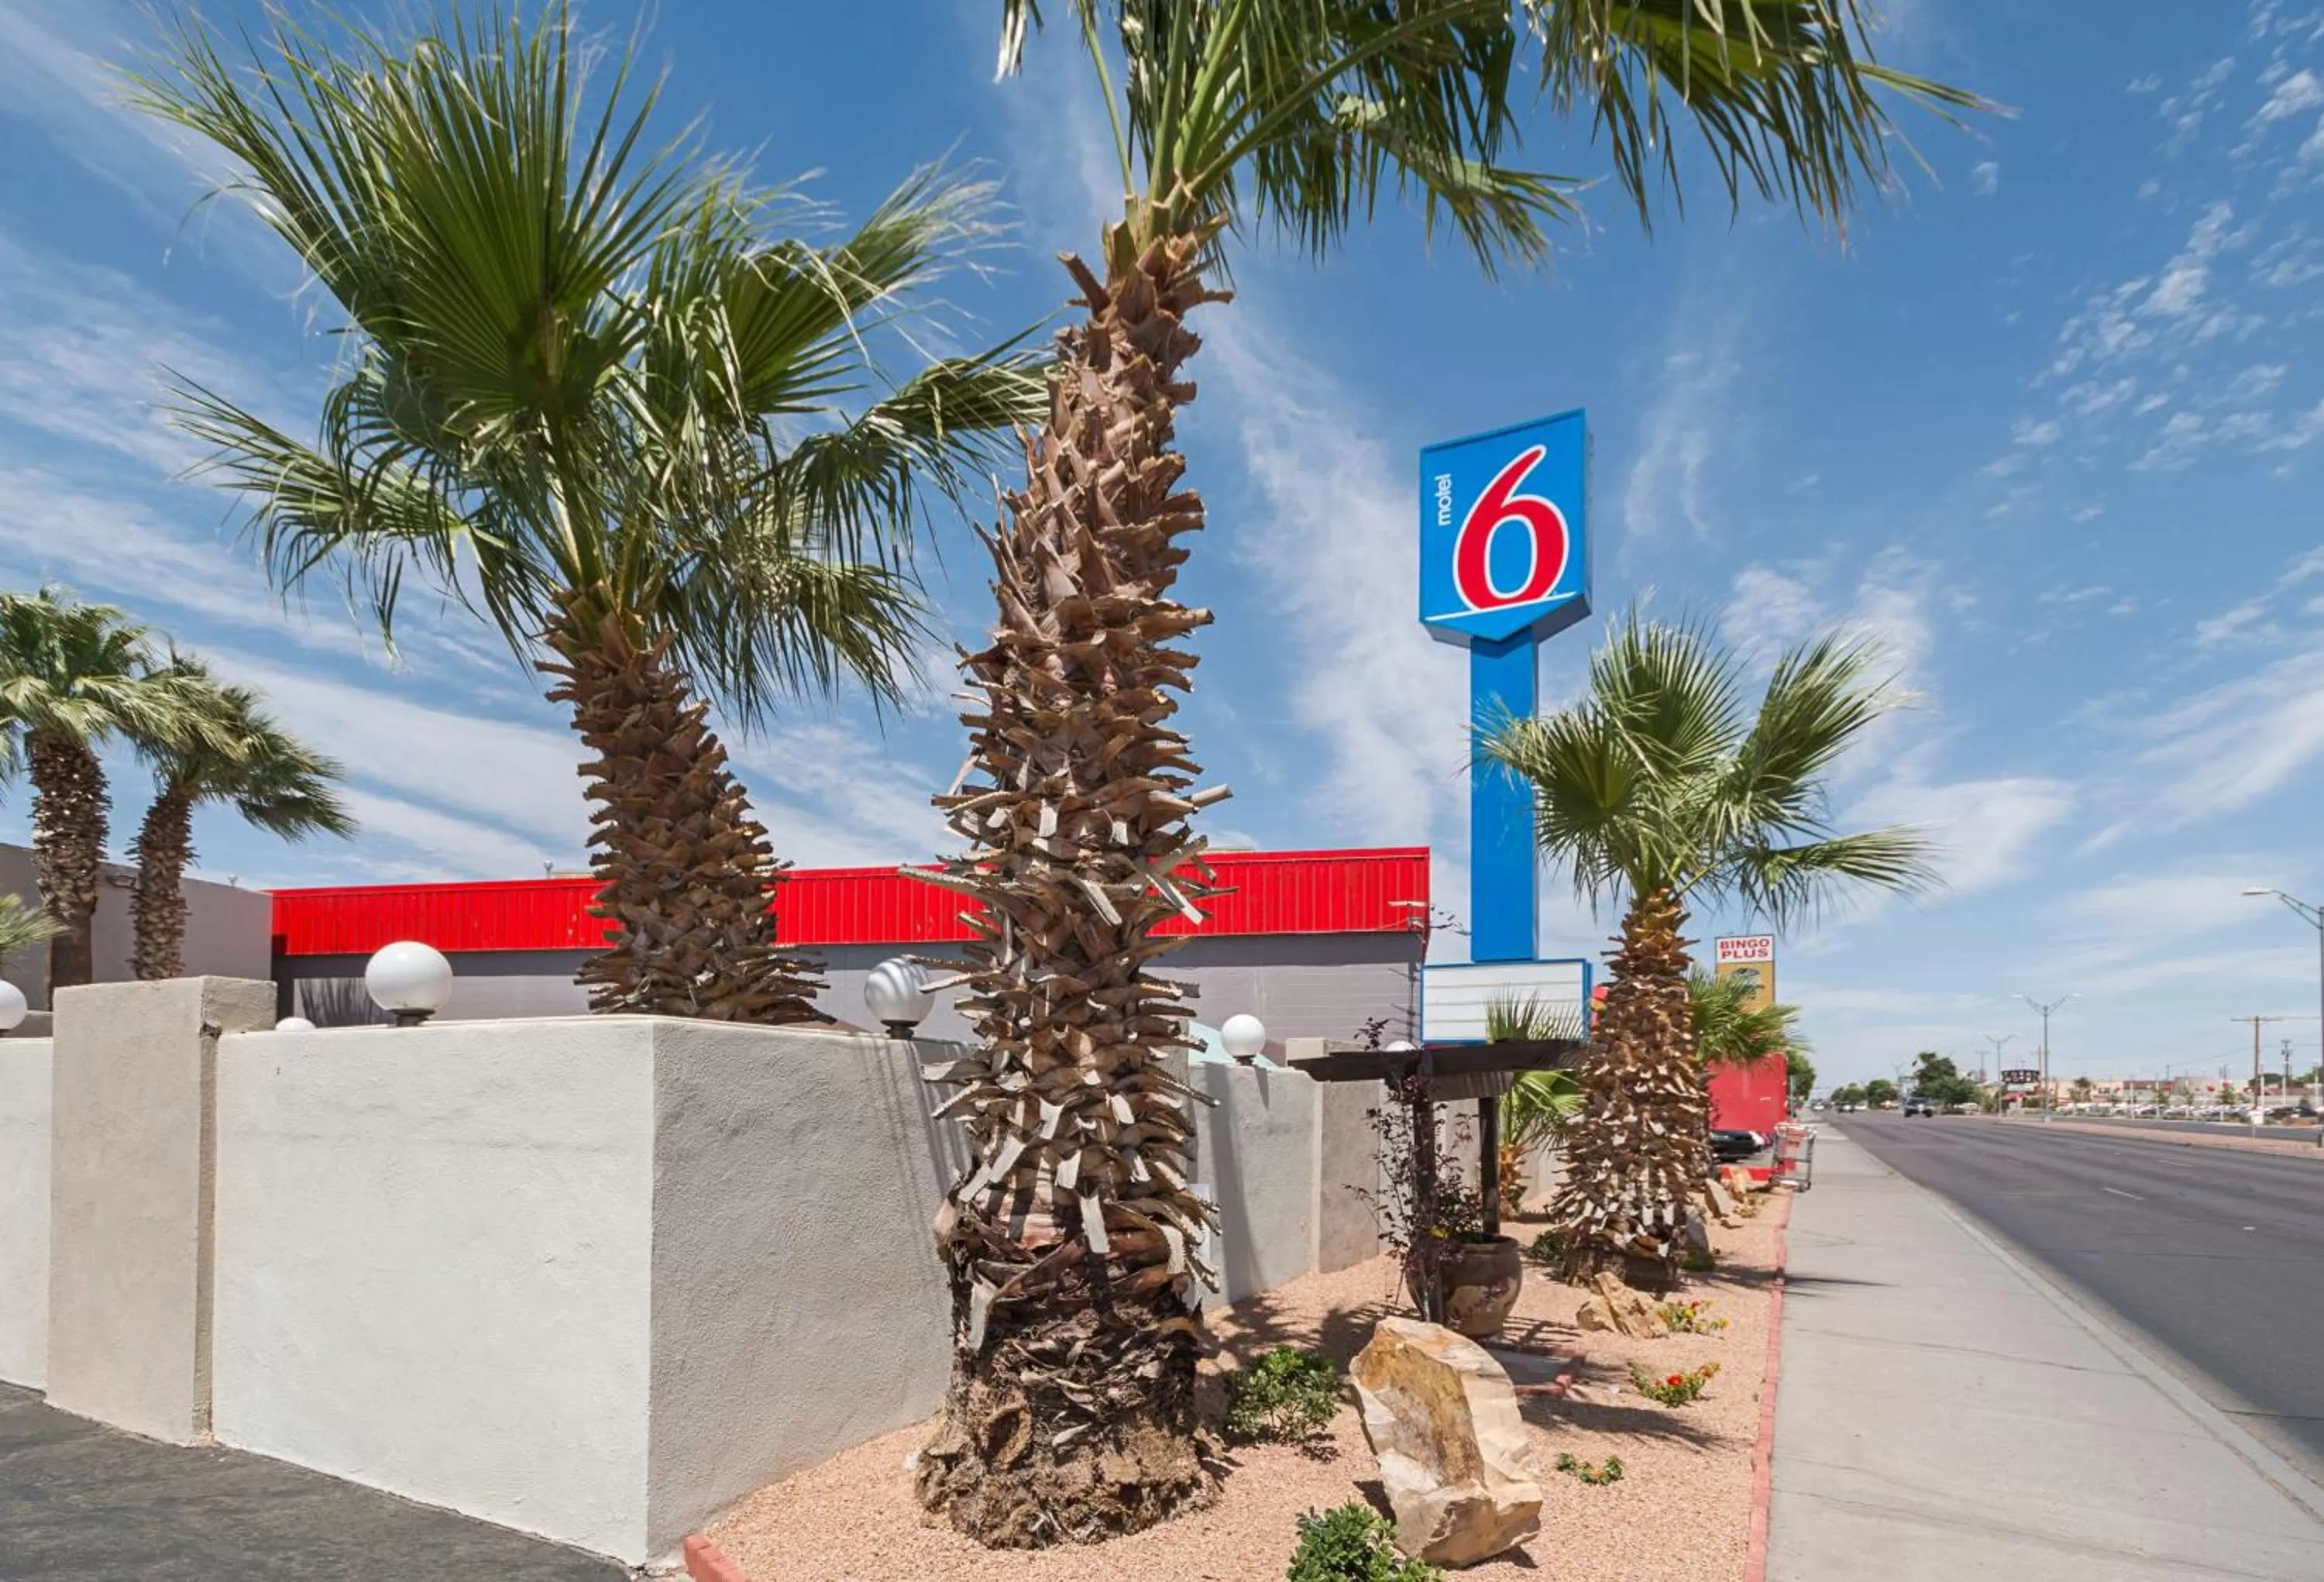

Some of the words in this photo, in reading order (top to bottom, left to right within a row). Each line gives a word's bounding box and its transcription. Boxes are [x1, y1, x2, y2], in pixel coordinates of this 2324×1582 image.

[1434, 473, 1451, 527] motel
[1453, 444, 1569, 611] 6
[1720, 938, 1770, 949] BINGO
[1721, 948, 1769, 959] PLUS
